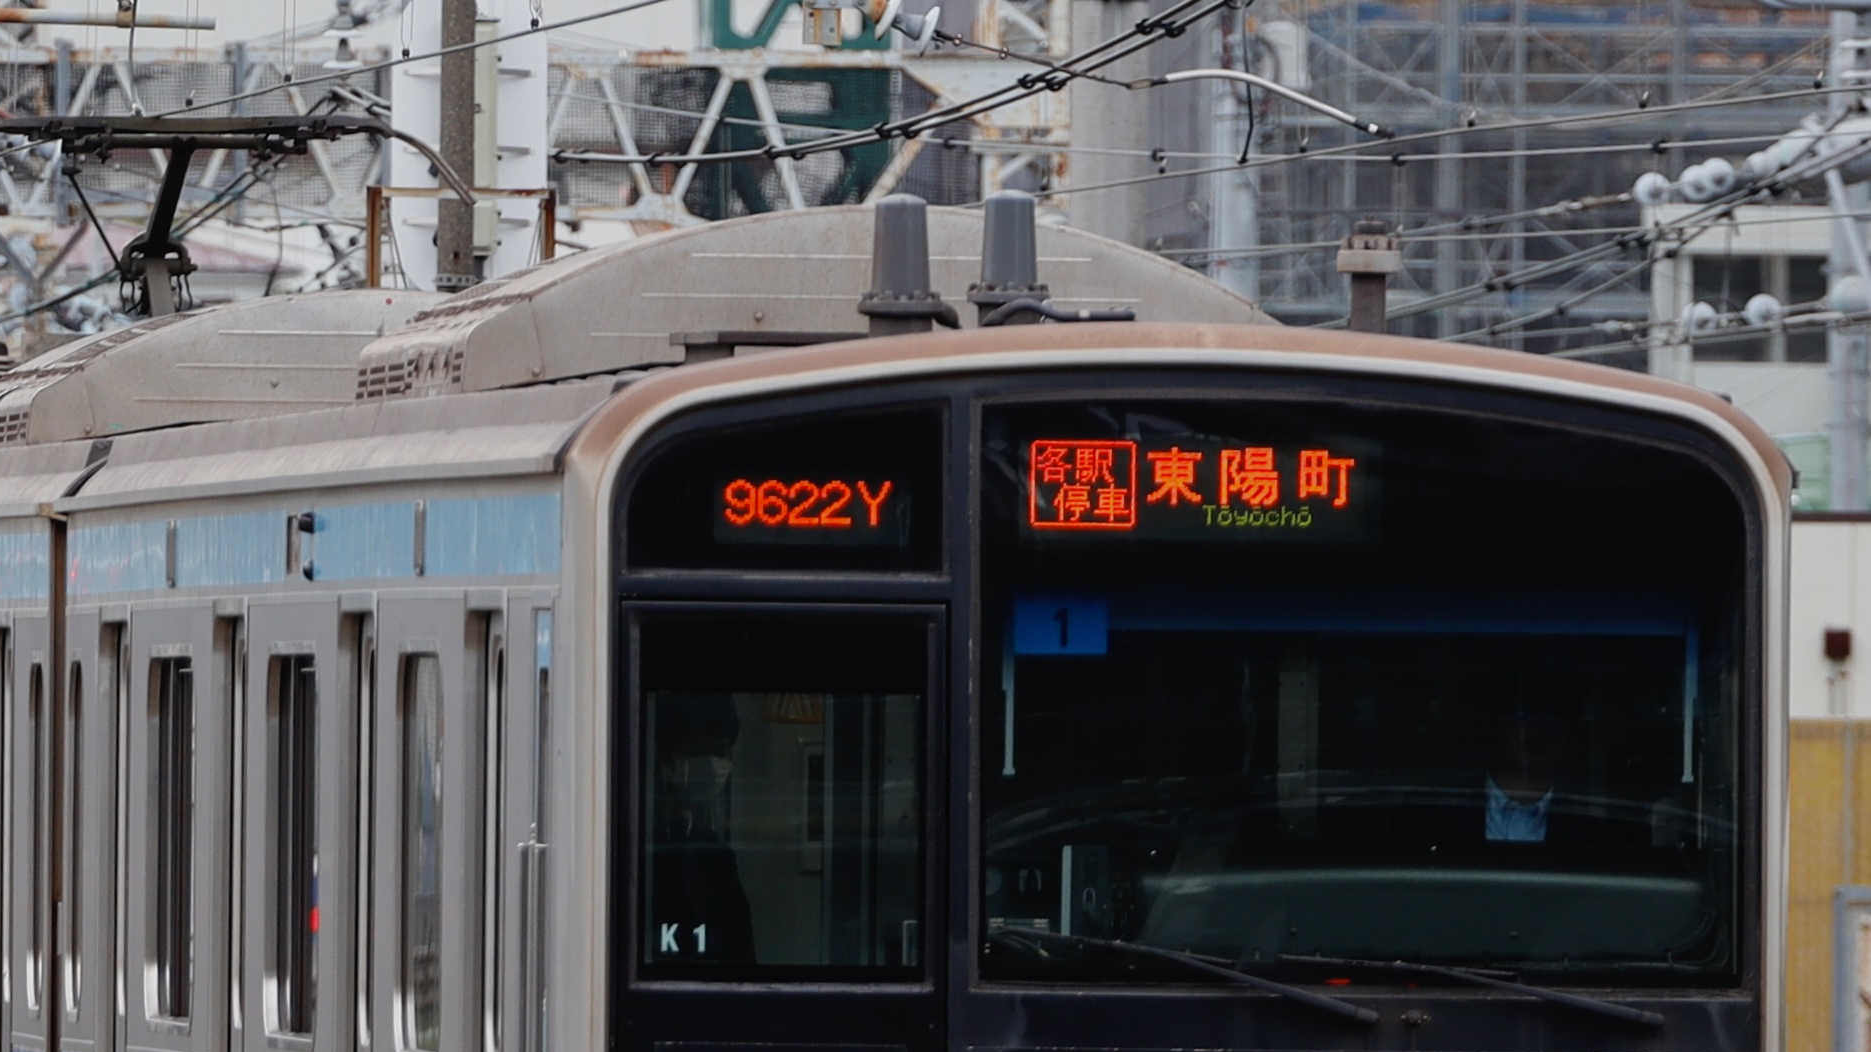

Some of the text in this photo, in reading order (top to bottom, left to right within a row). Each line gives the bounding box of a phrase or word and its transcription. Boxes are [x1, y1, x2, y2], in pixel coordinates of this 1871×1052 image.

[1036, 446, 1114, 483] 各駅
[1146, 446, 1355, 507] 東陽町
[724, 479, 892, 526] 9622Y
[1053, 484, 1130, 522] 停車
